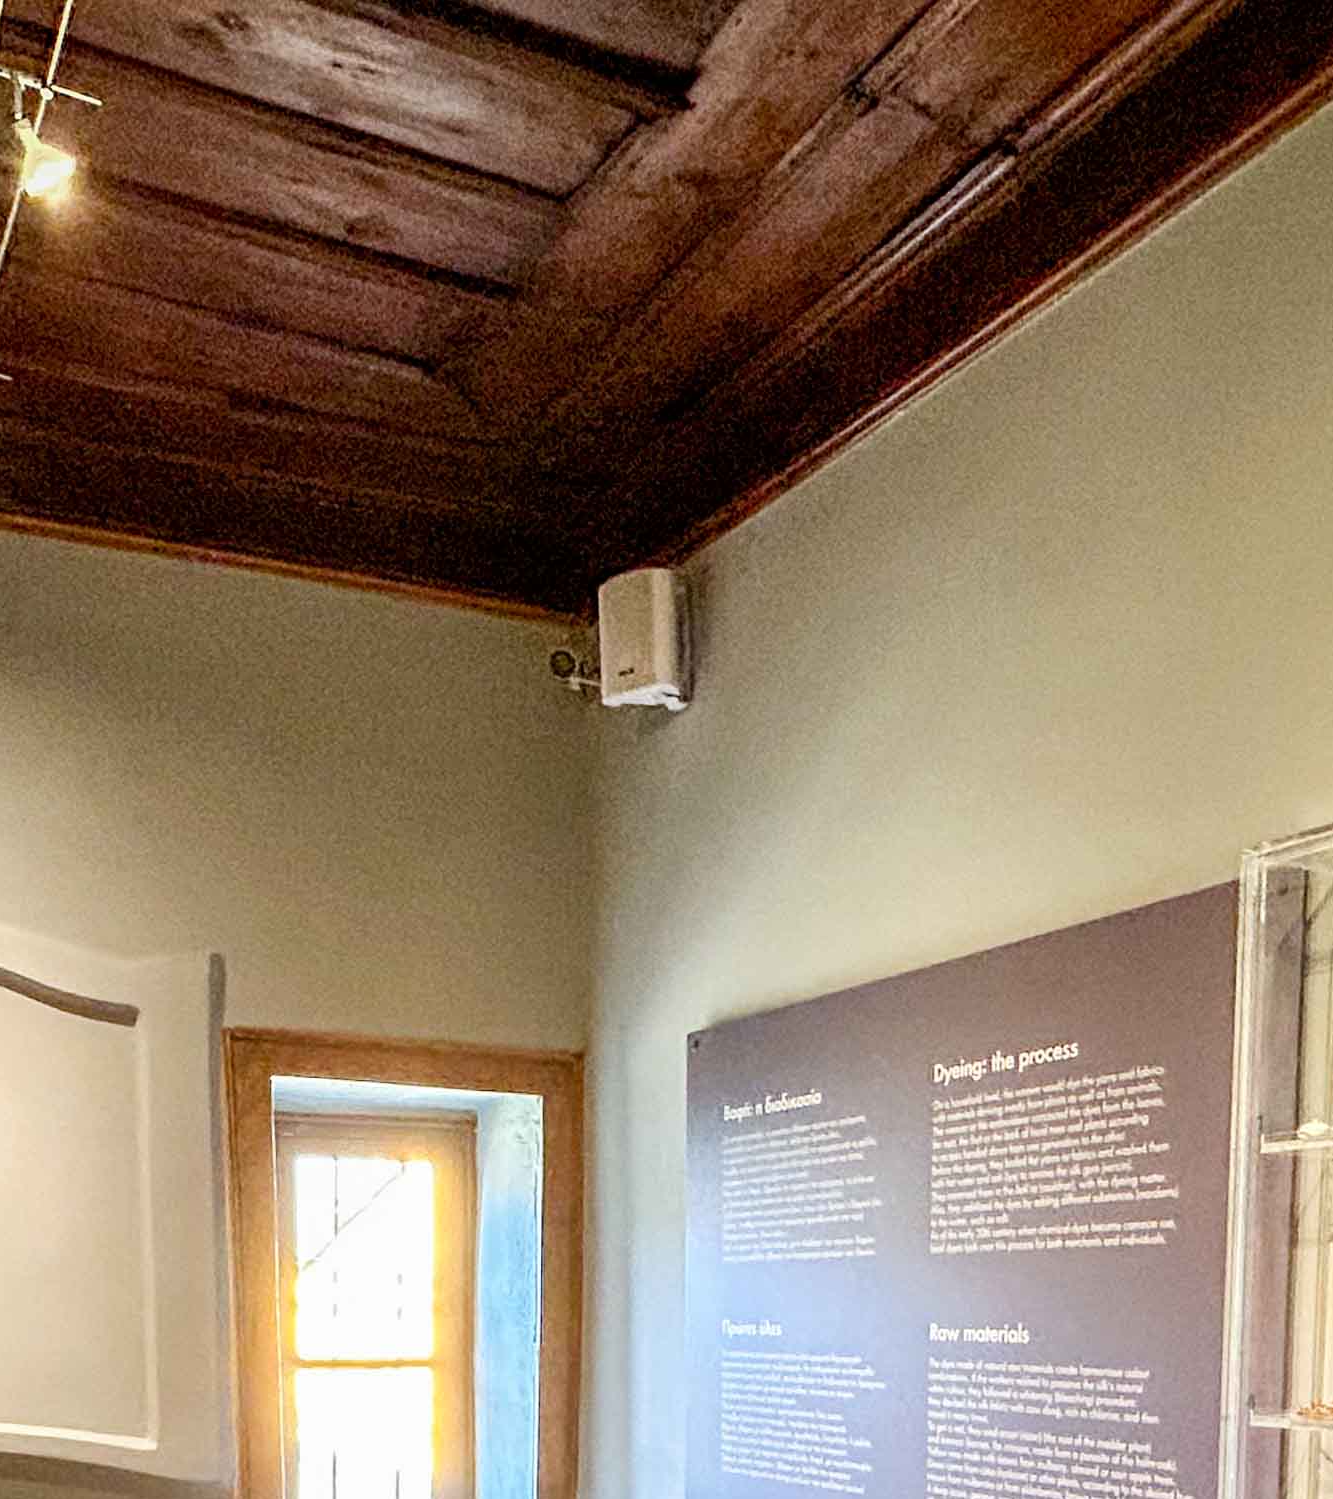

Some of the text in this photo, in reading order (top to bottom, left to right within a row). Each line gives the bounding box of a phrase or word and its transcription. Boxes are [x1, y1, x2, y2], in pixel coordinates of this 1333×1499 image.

[934, 1042, 1078, 1086] Dyeing: the process
[930, 1323, 1030, 1344] Raw materials
